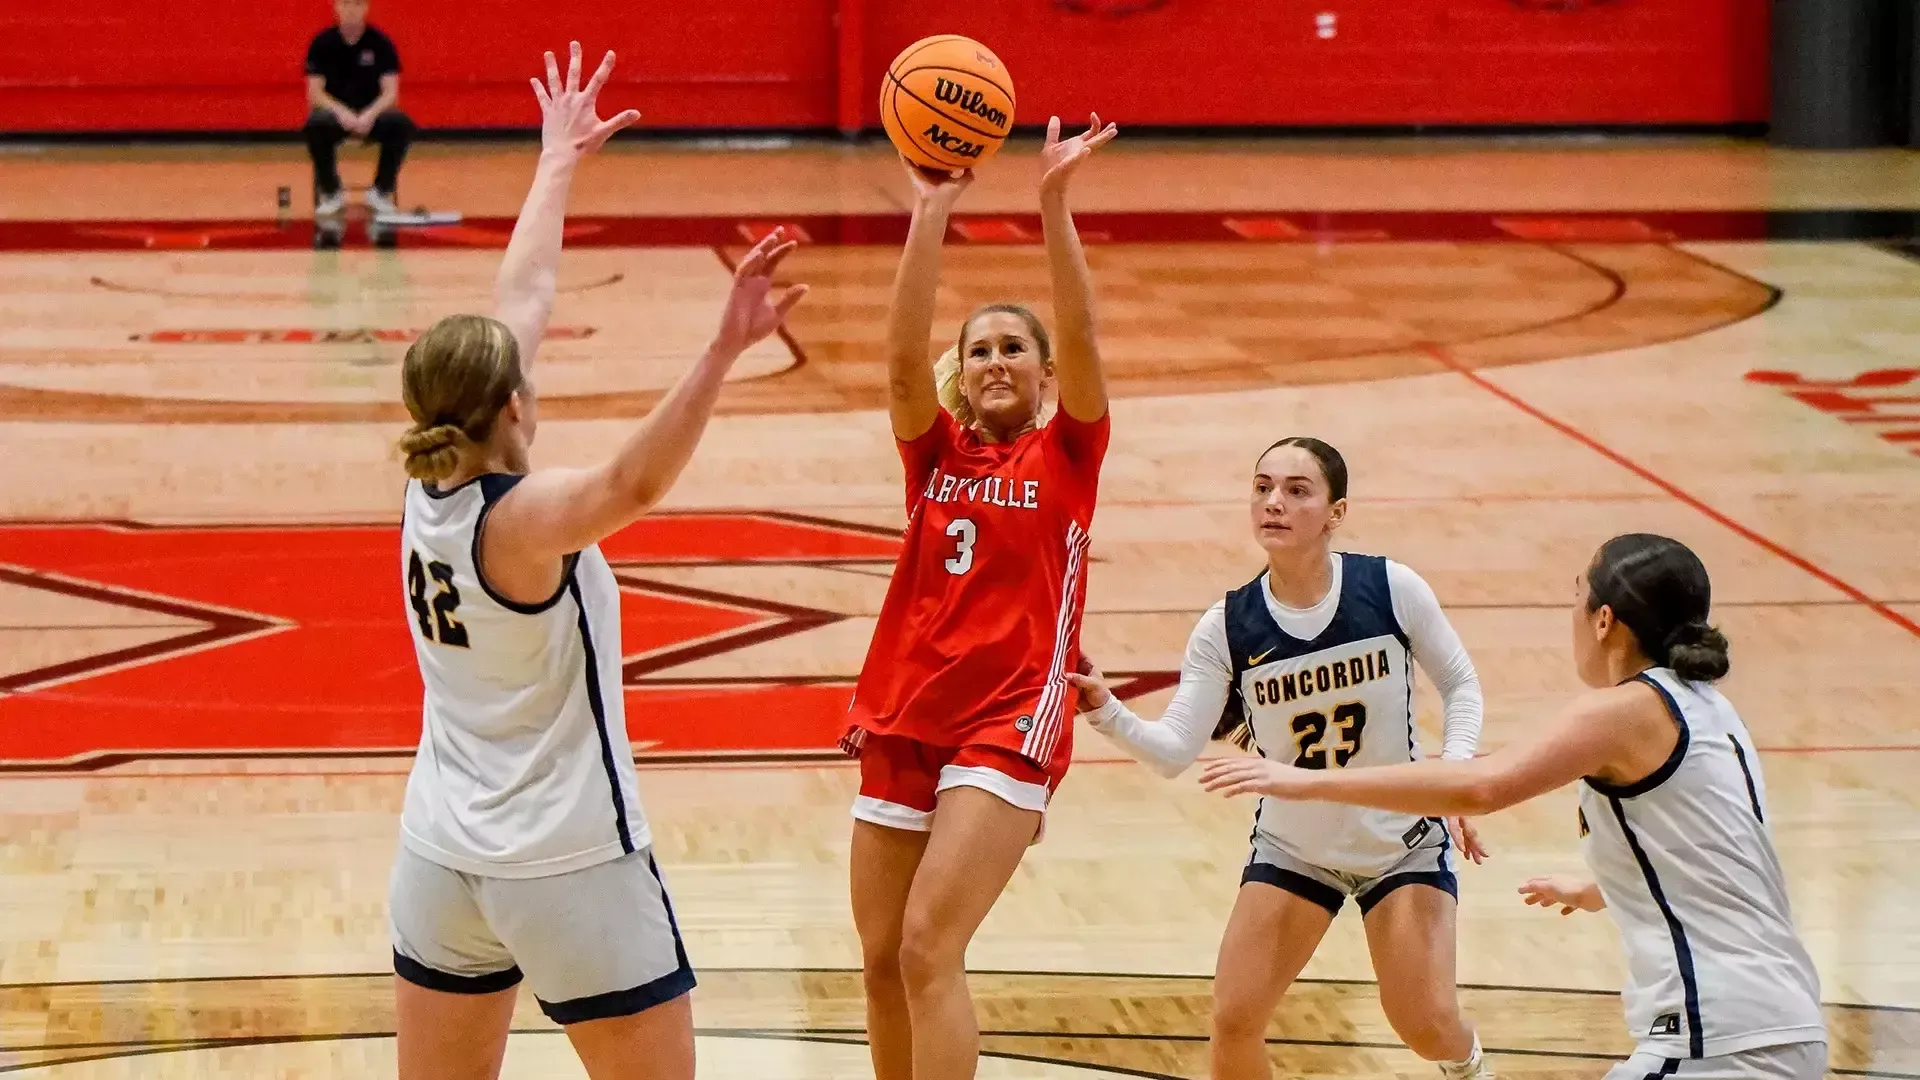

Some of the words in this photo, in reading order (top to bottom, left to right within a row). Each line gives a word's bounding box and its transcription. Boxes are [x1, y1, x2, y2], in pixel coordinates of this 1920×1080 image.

[934, 76, 1007, 129] Wilson
[922, 123, 985, 159] NCAA
[923, 467, 1039, 509] ARYVILLE
[944, 518, 977, 576] 3
[407, 547, 471, 650] 42
[1253, 648, 1391, 707] CONCORDIA
[1289, 700, 1368, 770] 23
